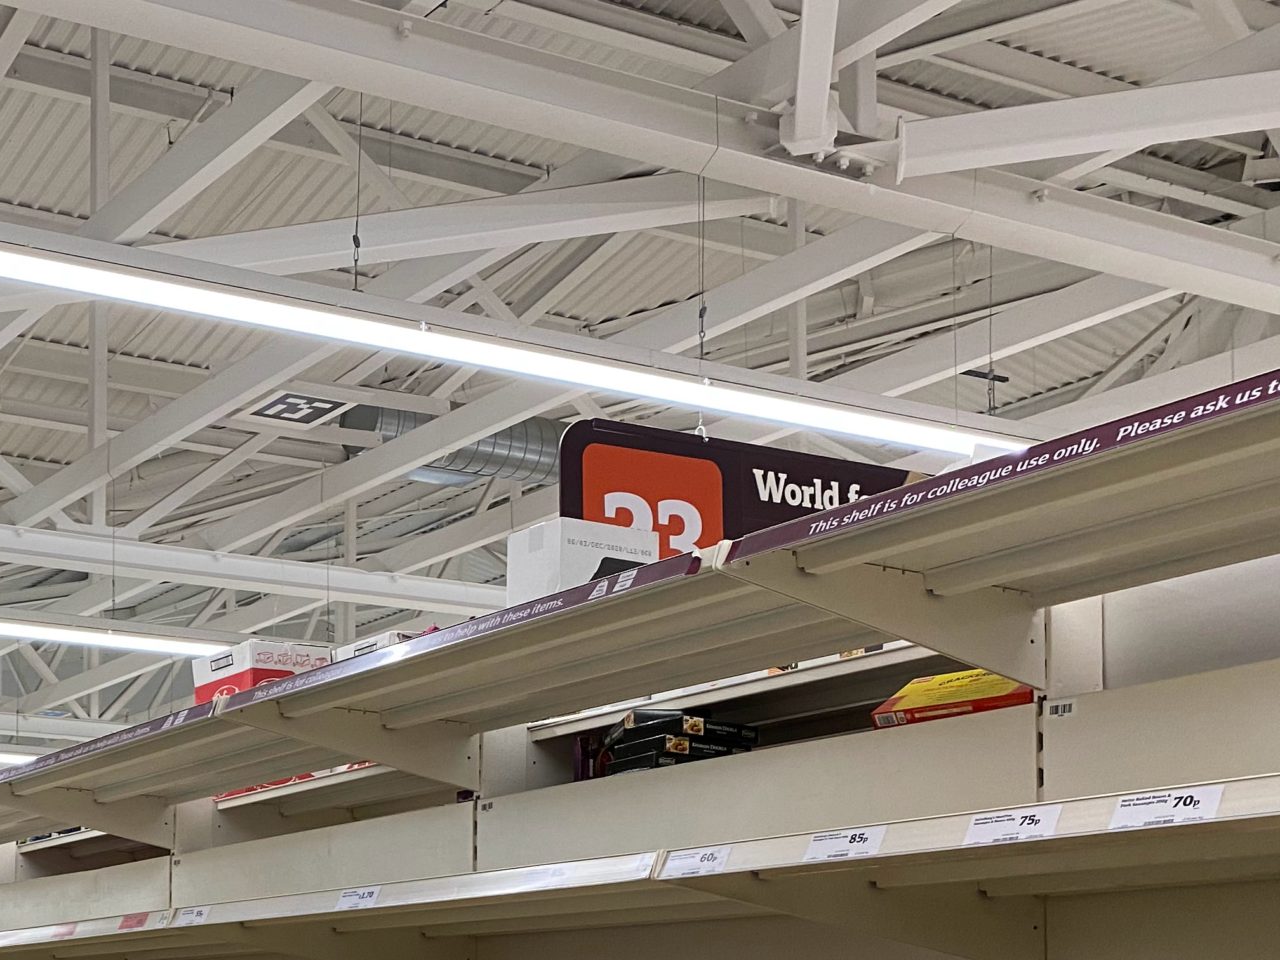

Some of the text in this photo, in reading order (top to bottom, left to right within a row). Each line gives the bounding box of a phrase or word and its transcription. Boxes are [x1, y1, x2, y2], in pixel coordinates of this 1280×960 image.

[808, 516, 838, 535] This
[840, 503, 881, 525] shelf
[883, 498, 899, 513] is
[899, 491, 926, 508] for
[927, 463, 1013, 500] colleague
[1016, 452, 1048, 472] use
[1053, 436, 1102, 462] only.
[1116, 411, 1187, 442] Please
[1189, 394, 1232, 419] ask
[1234, 385, 1262, 403] us
[752, 468, 840, 511] World
[502, 608, 530, 624] these
[1172, 794, 1201, 809] 70p
[1018, 814, 1041, 827] 75p
[849, 832, 869, 844] 85p
[699, 852, 718, 864] 60p
